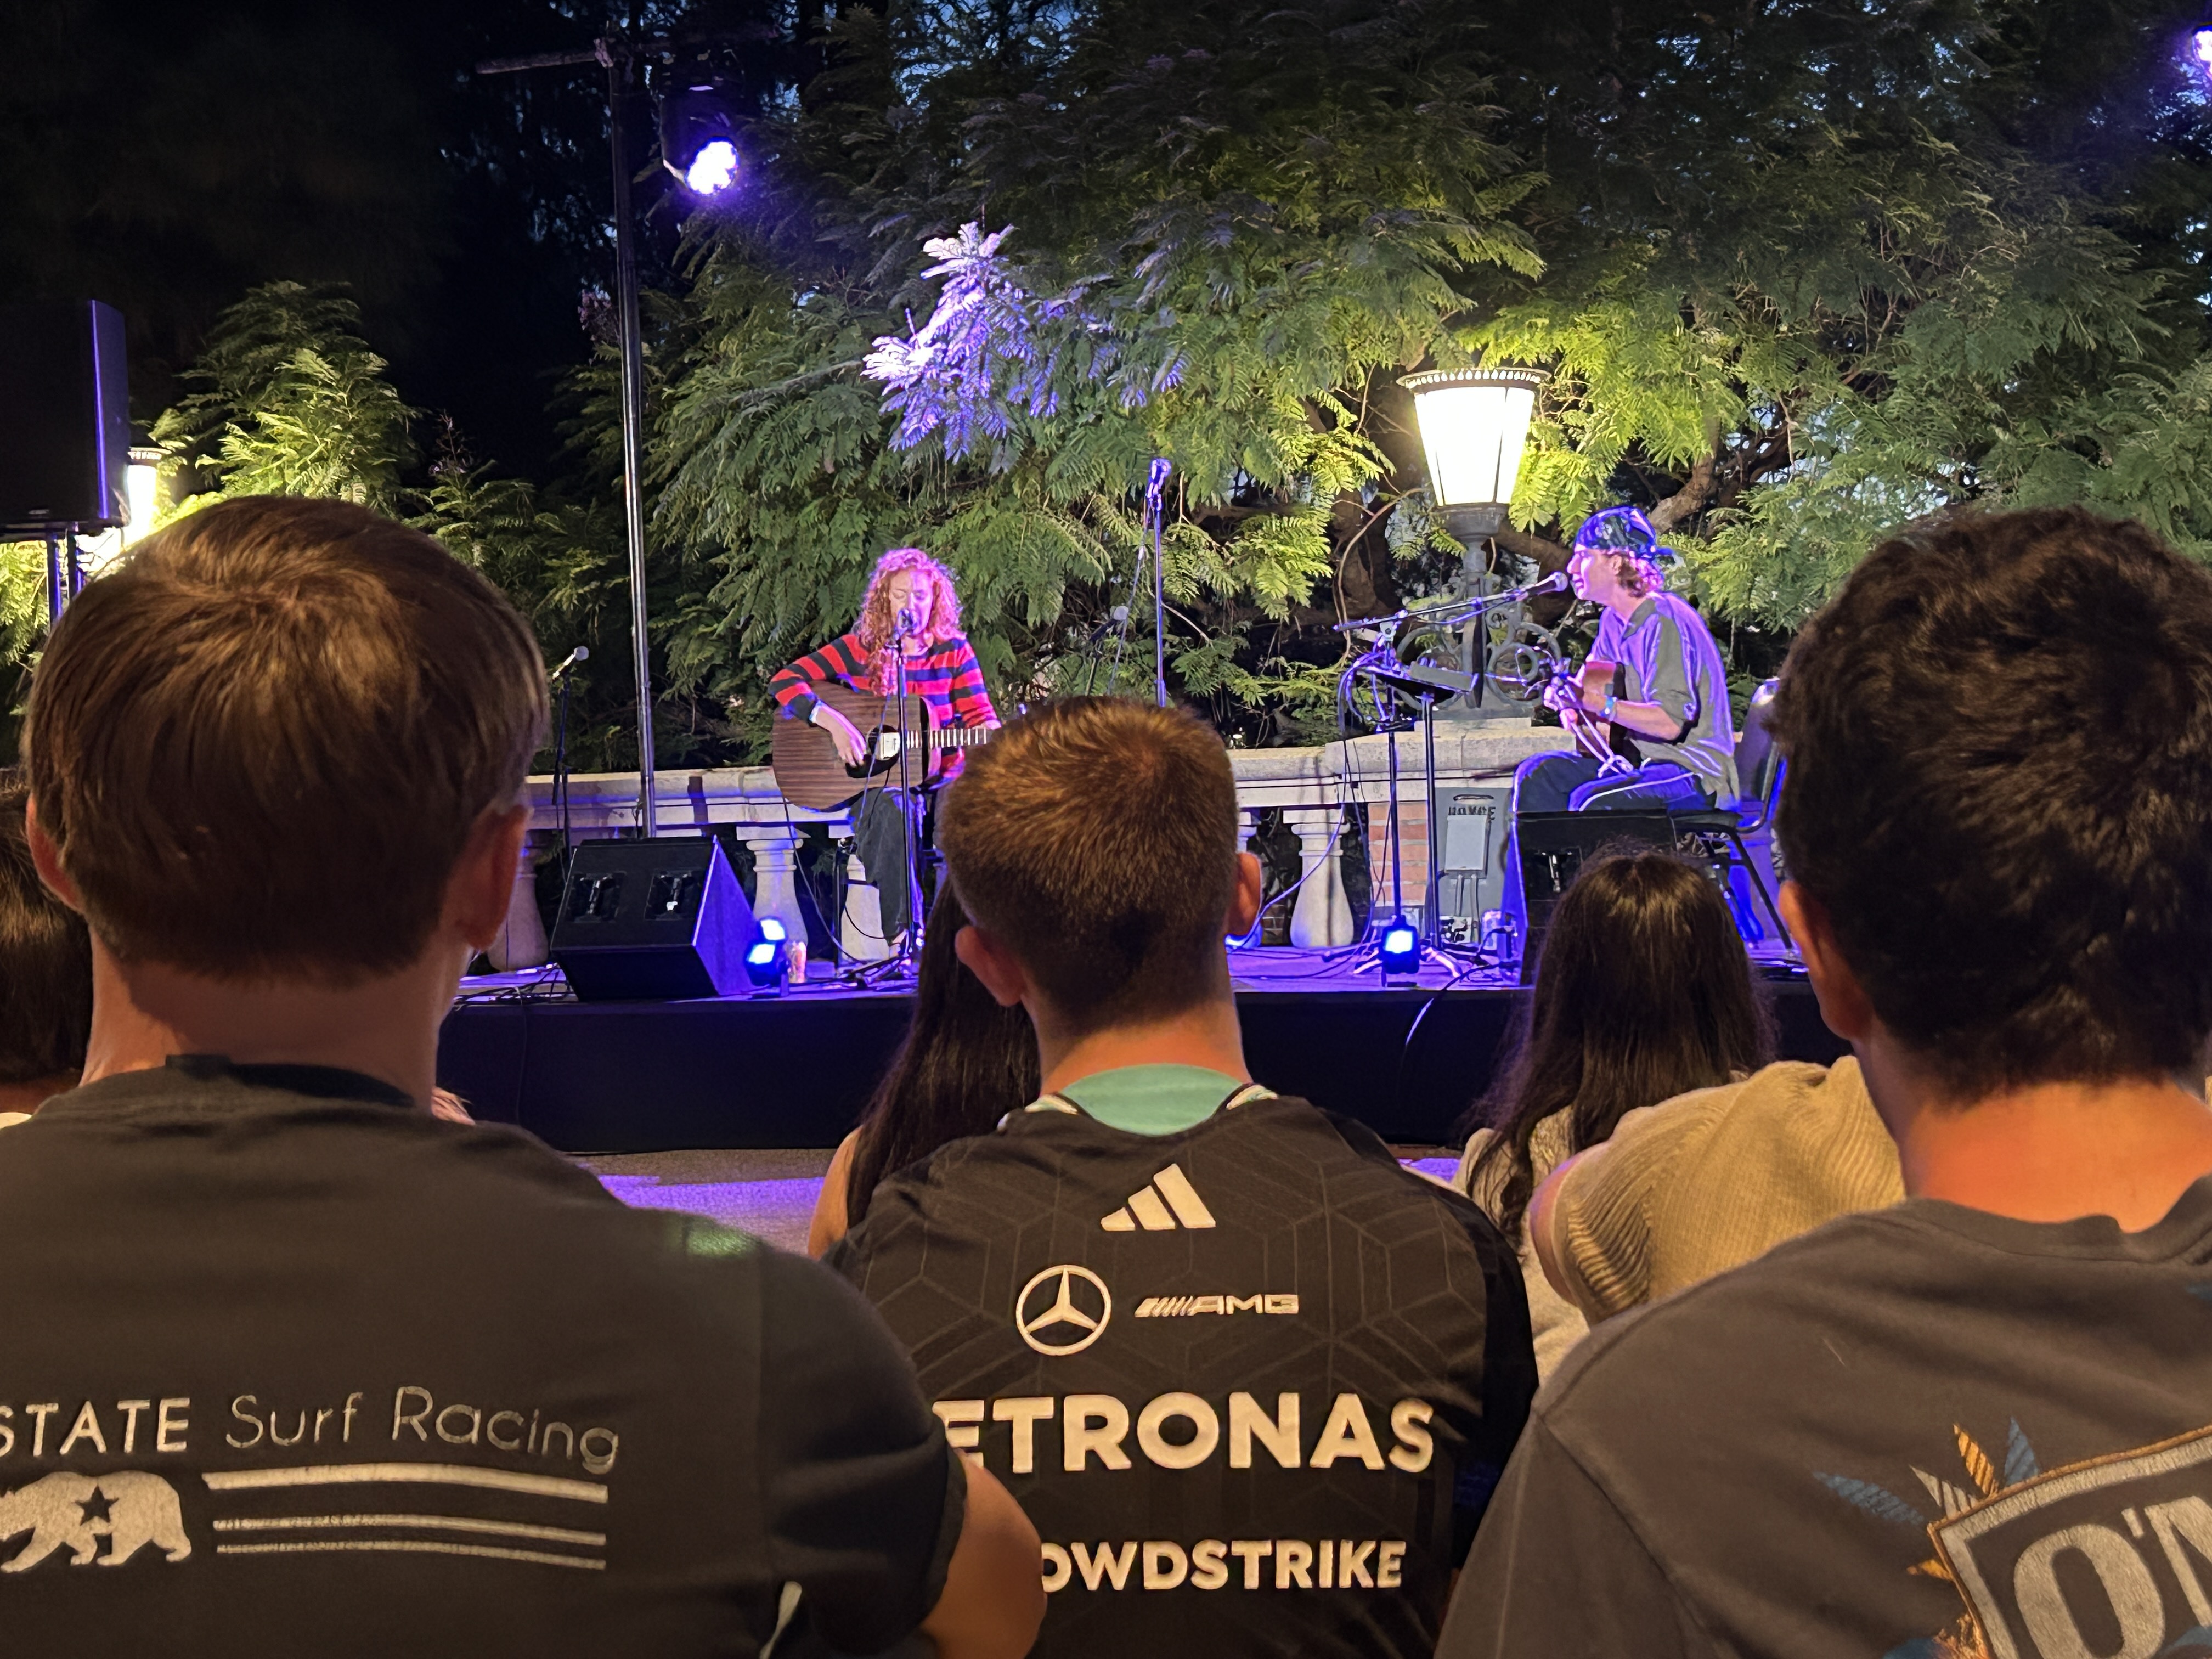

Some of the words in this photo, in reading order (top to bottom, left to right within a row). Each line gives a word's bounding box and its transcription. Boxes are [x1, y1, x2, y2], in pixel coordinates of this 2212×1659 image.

[1189, 1294, 1299, 1316] AMG
[226, 1391, 364, 1449] Surf
[391, 1386, 619, 1475] Racing
[932, 1394, 1434, 1473] ETRONAS
[1042, 1539, 1406, 1593] OWDSTRIKE
